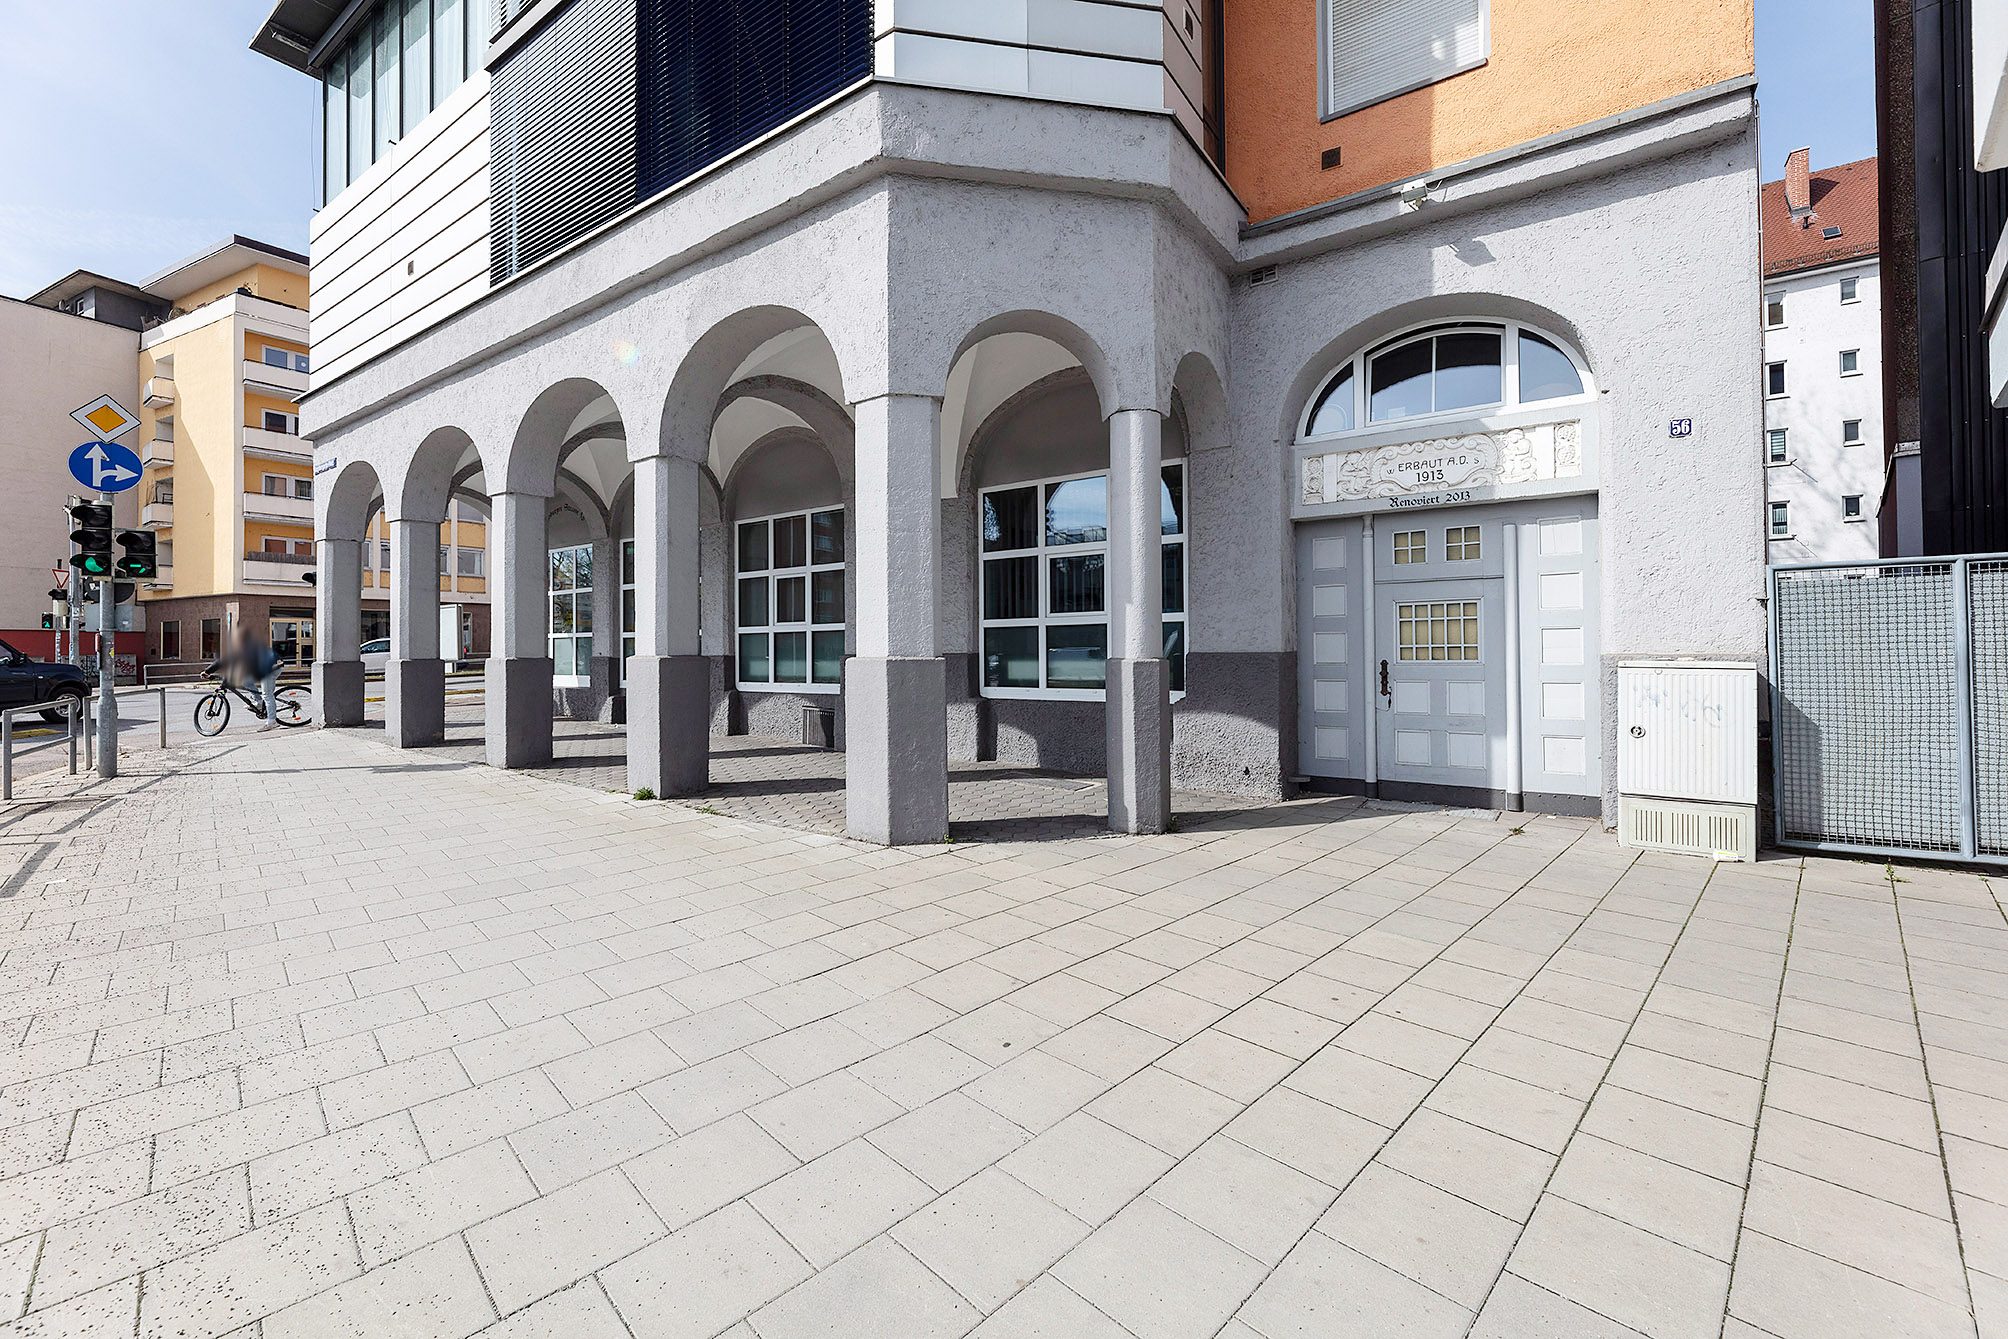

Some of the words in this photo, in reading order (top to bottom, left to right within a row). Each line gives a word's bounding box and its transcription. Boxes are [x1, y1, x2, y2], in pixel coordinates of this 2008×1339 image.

[1672, 419, 1690, 435] 56
[1398, 458, 1443, 472] ERBAUT
[1447, 455, 1469, 466] A.D.
[1416, 469, 1444, 482] 1913
[1389, 495, 1440, 508] Renoviert
[1445, 490, 1471, 503] 2013
